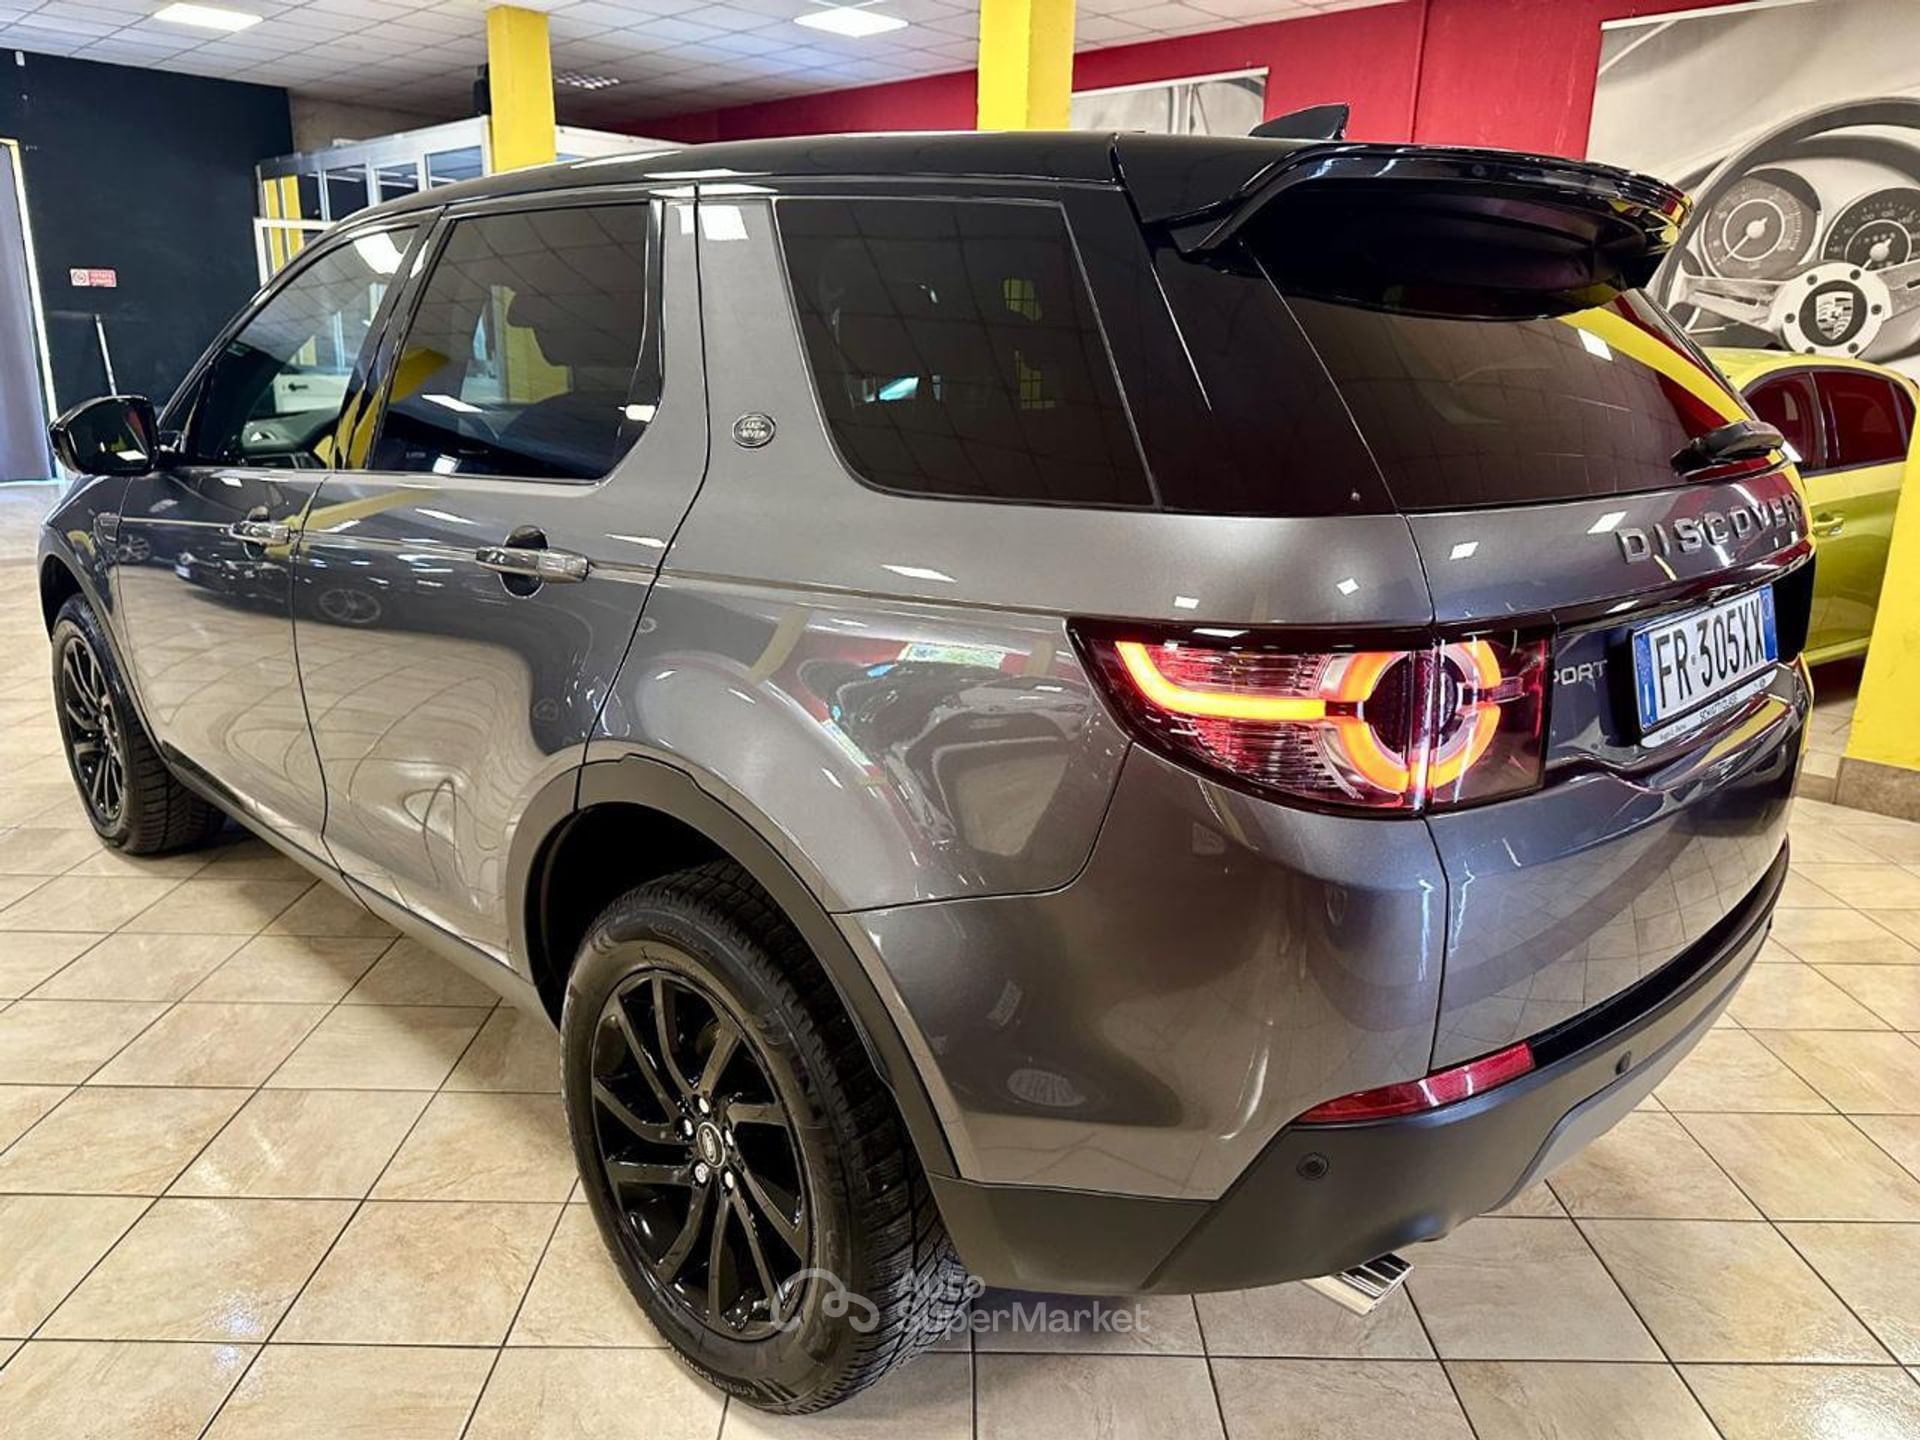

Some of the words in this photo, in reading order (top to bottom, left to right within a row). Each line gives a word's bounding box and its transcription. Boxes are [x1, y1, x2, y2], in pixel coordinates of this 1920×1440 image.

[1615, 492, 1801, 564] DISCOVER
[1655, 628, 1693, 709] FR
[1696, 598, 1764, 688] 305XX
